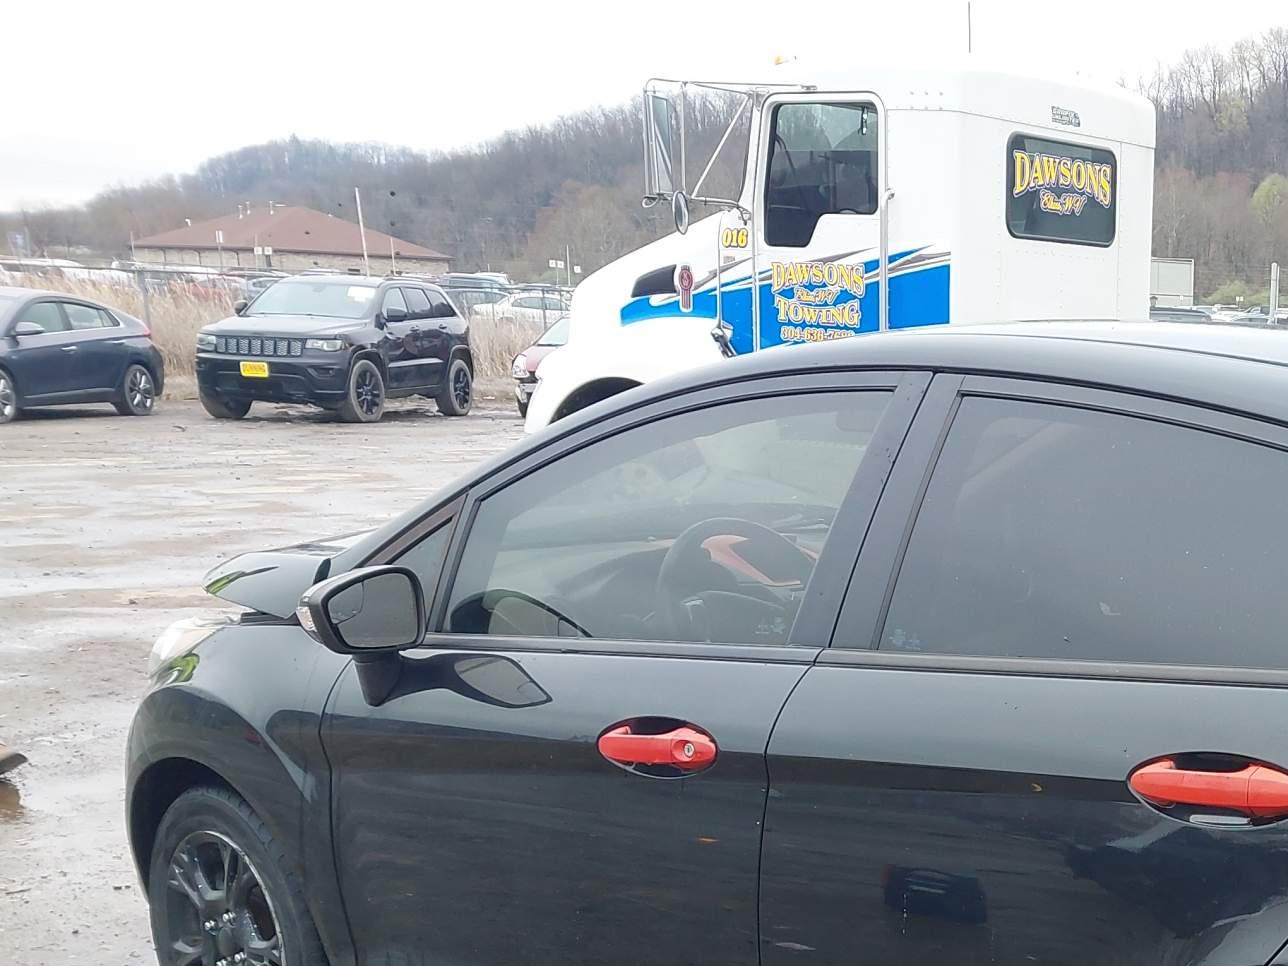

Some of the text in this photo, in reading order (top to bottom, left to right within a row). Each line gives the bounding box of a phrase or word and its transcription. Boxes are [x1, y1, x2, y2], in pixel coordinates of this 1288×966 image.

[1013, 150, 1112, 208] DAWSONS
[721, 227, 749, 248] 016
[771, 261, 865, 298] DAWSONS
[775, 295, 861, 328] TOWING
